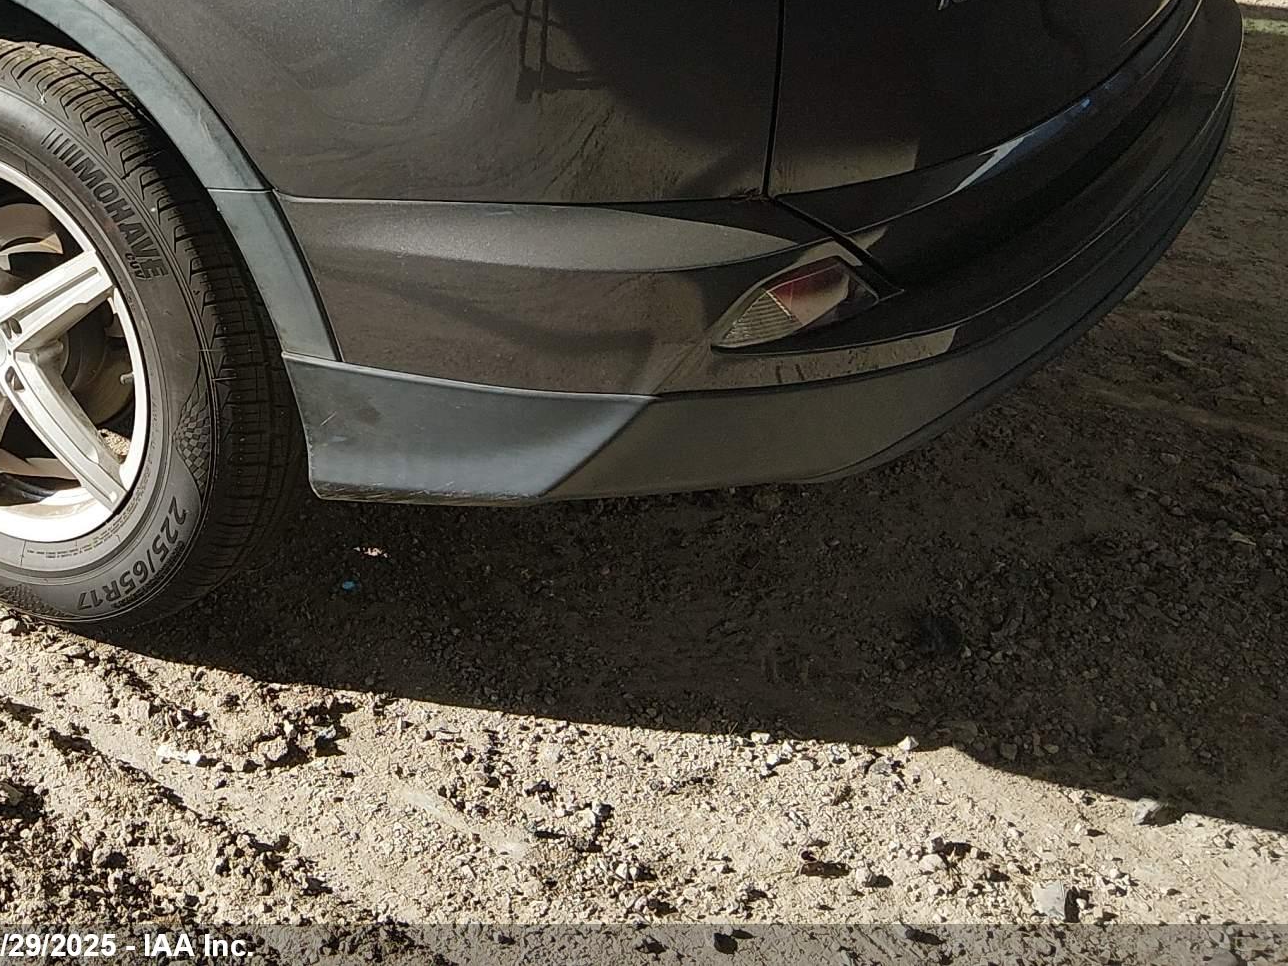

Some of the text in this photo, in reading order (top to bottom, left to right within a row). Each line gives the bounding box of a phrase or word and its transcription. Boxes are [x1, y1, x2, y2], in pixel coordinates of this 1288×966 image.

[71, 156, 169, 279] MOHAVE
[124, 251, 148, 281] CUV
[77, 495, 189, 611] 225/65R17
